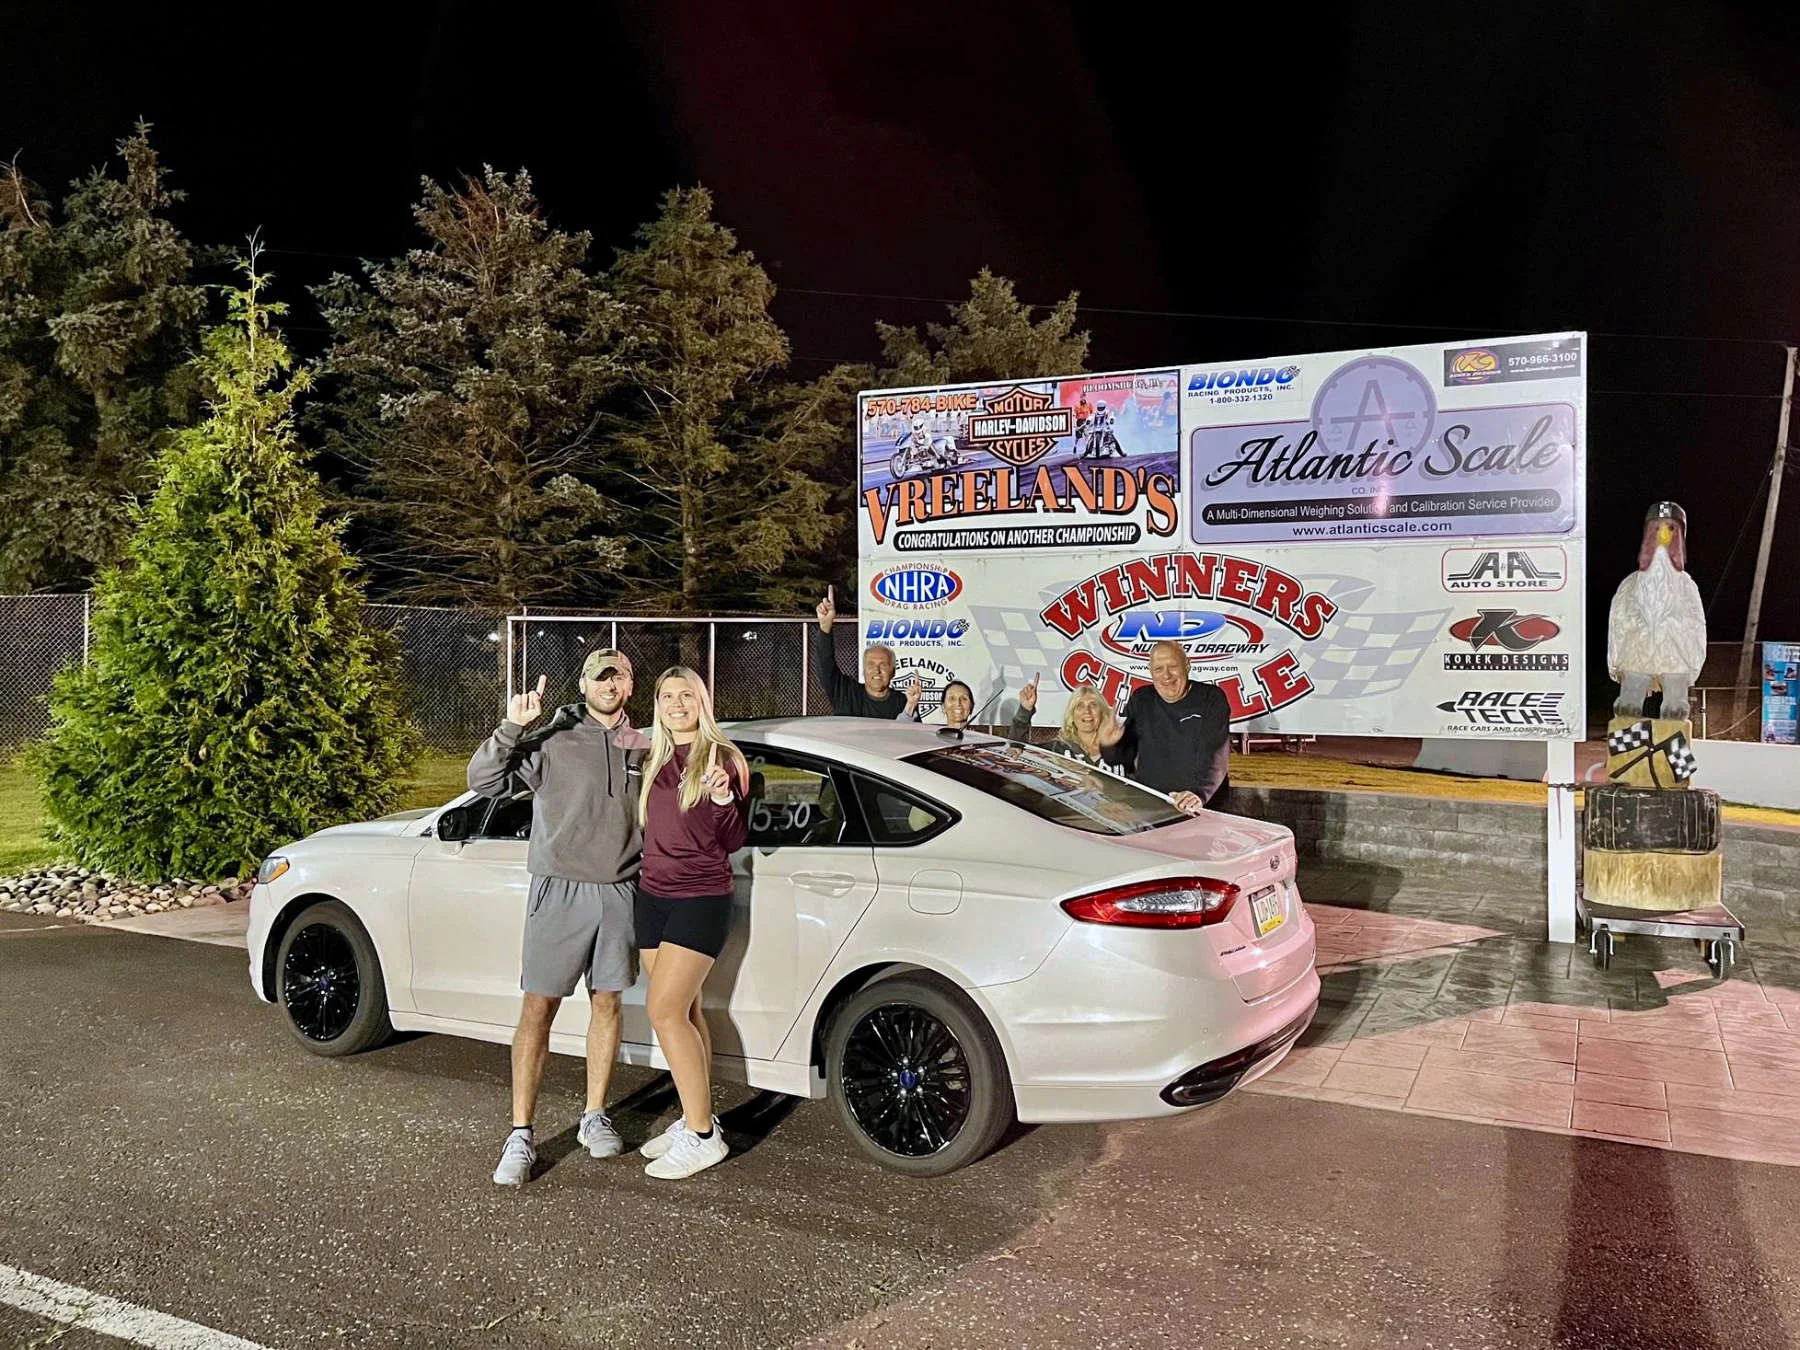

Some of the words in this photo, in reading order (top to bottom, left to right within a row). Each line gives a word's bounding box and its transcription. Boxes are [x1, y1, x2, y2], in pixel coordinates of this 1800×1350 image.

[1508, 352, 1578, 367] 570-966-3100
[1187, 365, 1301, 391] BIONDO
[1188, 389, 1219, 398] RACING
[1224, 386, 1272, 395] PRODUCTS,
[1210, 393, 1273, 405] 1-800-332-1320
[867, 393, 978, 417] 570-784-BIKE
[993, 396, 1044, 414] MOTOR
[974, 414, 1067, 437] HARLEY-DAVIDSON
[996, 437, 1046, 460] CYCLES
[1204, 430, 1413, 487] Atlantic
[1423, 413, 1563, 477] Scale
[864, 465, 1179, 545] VREELAND'S
[1206, 510, 1215, 521] A
[1216, 506, 1298, 521] Multi-Dimensional
[1300, 504, 1345, 518] Weighing
[1389, 501, 1408, 513] and
[1410, 499, 1465, 513] Calibration
[1468, 497, 1508, 511] Service
[1510, 494, 1554, 509] Provider
[1292, 520, 1452, 536] www.atlanticscale.com
[898, 530, 990, 549] CONGRATULATIONS
[991, 529, 1006, 546] ON
[1007, 528, 1054, 546] ANOTHER
[1056, 525, 1137, 544] CHAMPIONSHIP
[884, 562, 948, 575] CHAMPIONSHIP
[884, 572, 950, 602] NHRA
[1450, 580, 1491, 589] AUTO
[1497, 579, 1548, 588] STORE
[885, 599, 909, 610] DRAG
[913, 598, 948, 610] RACING
[1040, 551, 1338, 640] WINNERS
[866, 618, 970, 639] BIONDO
[900, 640, 943, 648] PRODUCTS,
[1195, 643, 1270, 654] DRAGWAY
[1444, 654, 1492, 665] KOREK
[1501, 654, 1569, 665] DESIGNS
[1457, 691, 1545, 708] RACE
[1457, 708, 1544, 725] TECH
